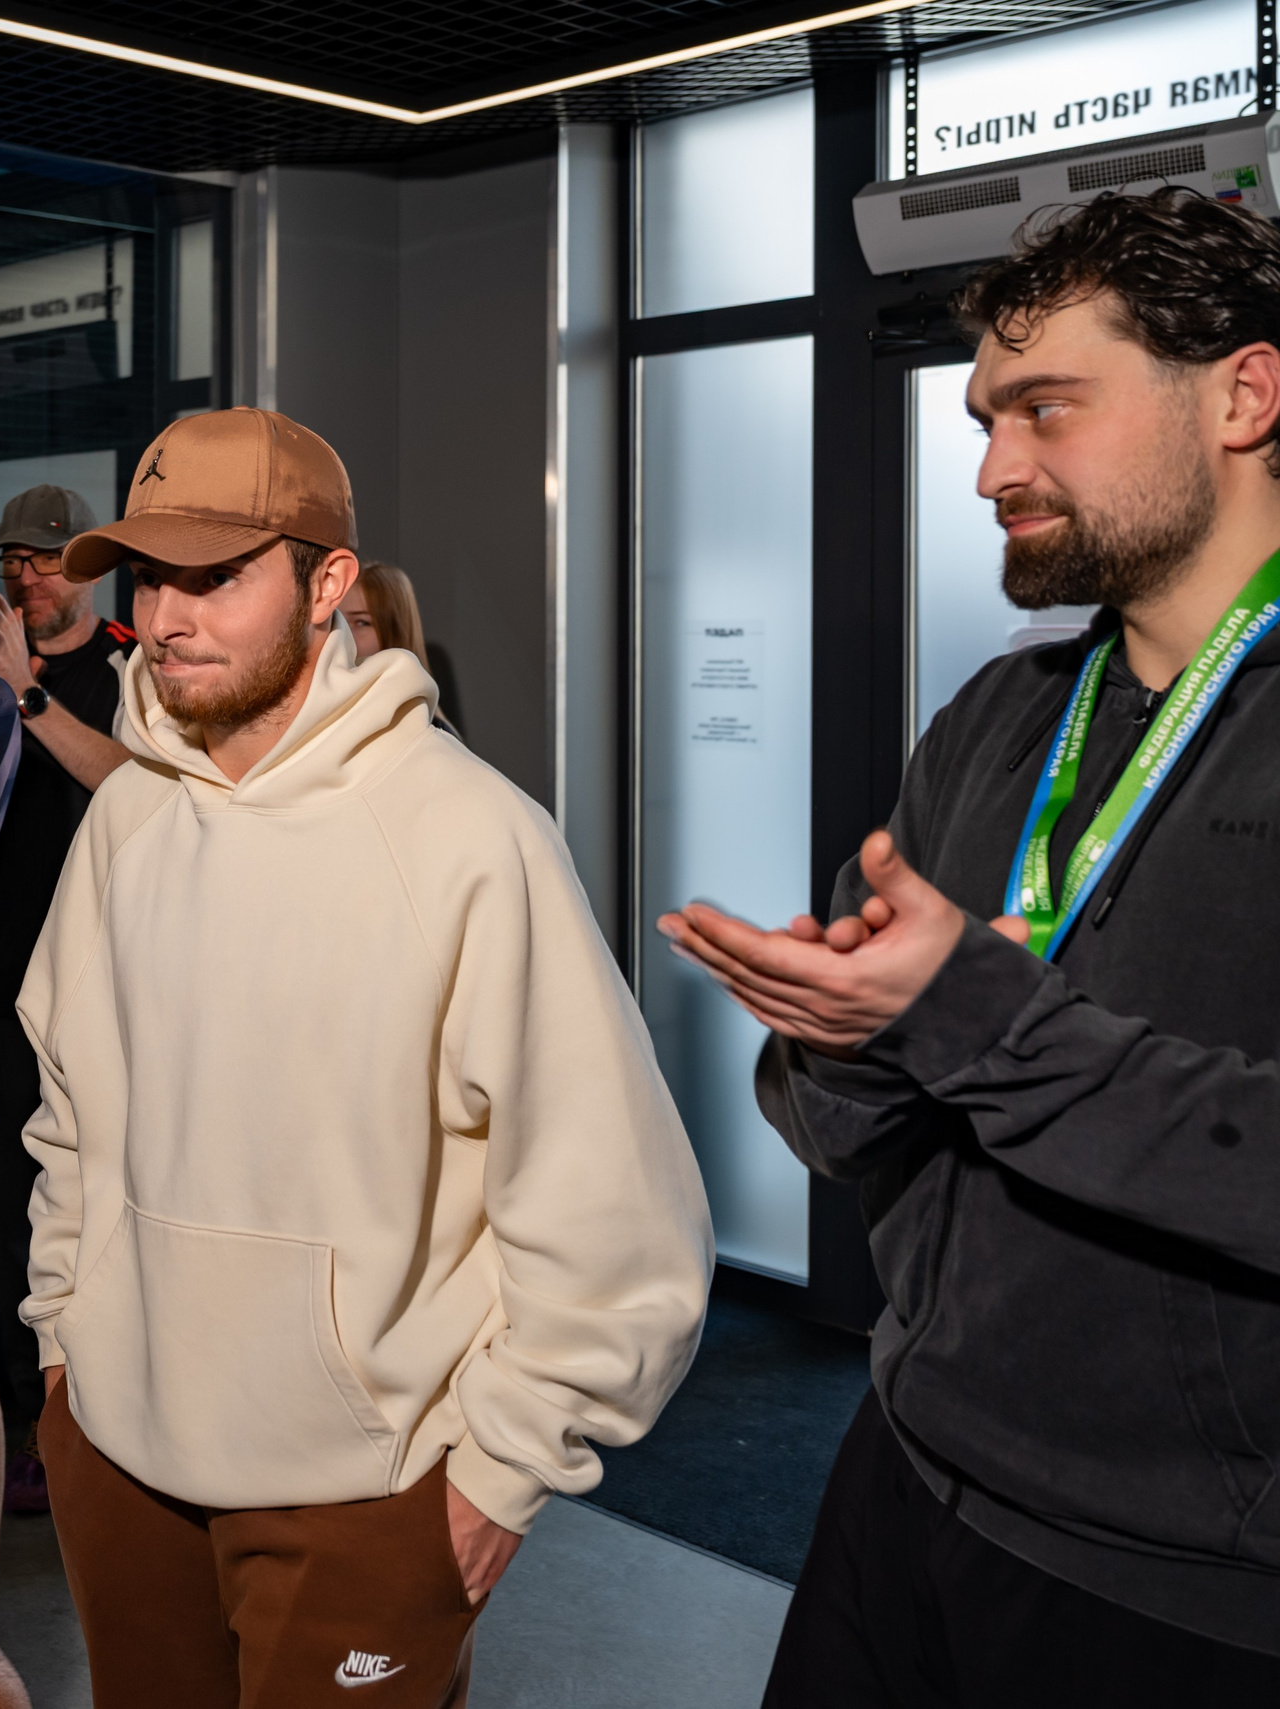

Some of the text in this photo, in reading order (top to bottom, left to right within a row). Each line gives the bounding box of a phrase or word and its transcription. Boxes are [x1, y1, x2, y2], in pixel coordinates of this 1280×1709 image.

[1138, 606, 1251, 769] ФЕДЕРАЦИЯ ПАДЕЛА
[1142, 602, 1280, 790] КРАСНОДАРСКОГО КРАЯ
[1047, 739, 1069, 778] КРАЯ
[1066, 699, 1090, 762] ПАДЕЛА
[345, 1649, 390, 1677] NIKE
